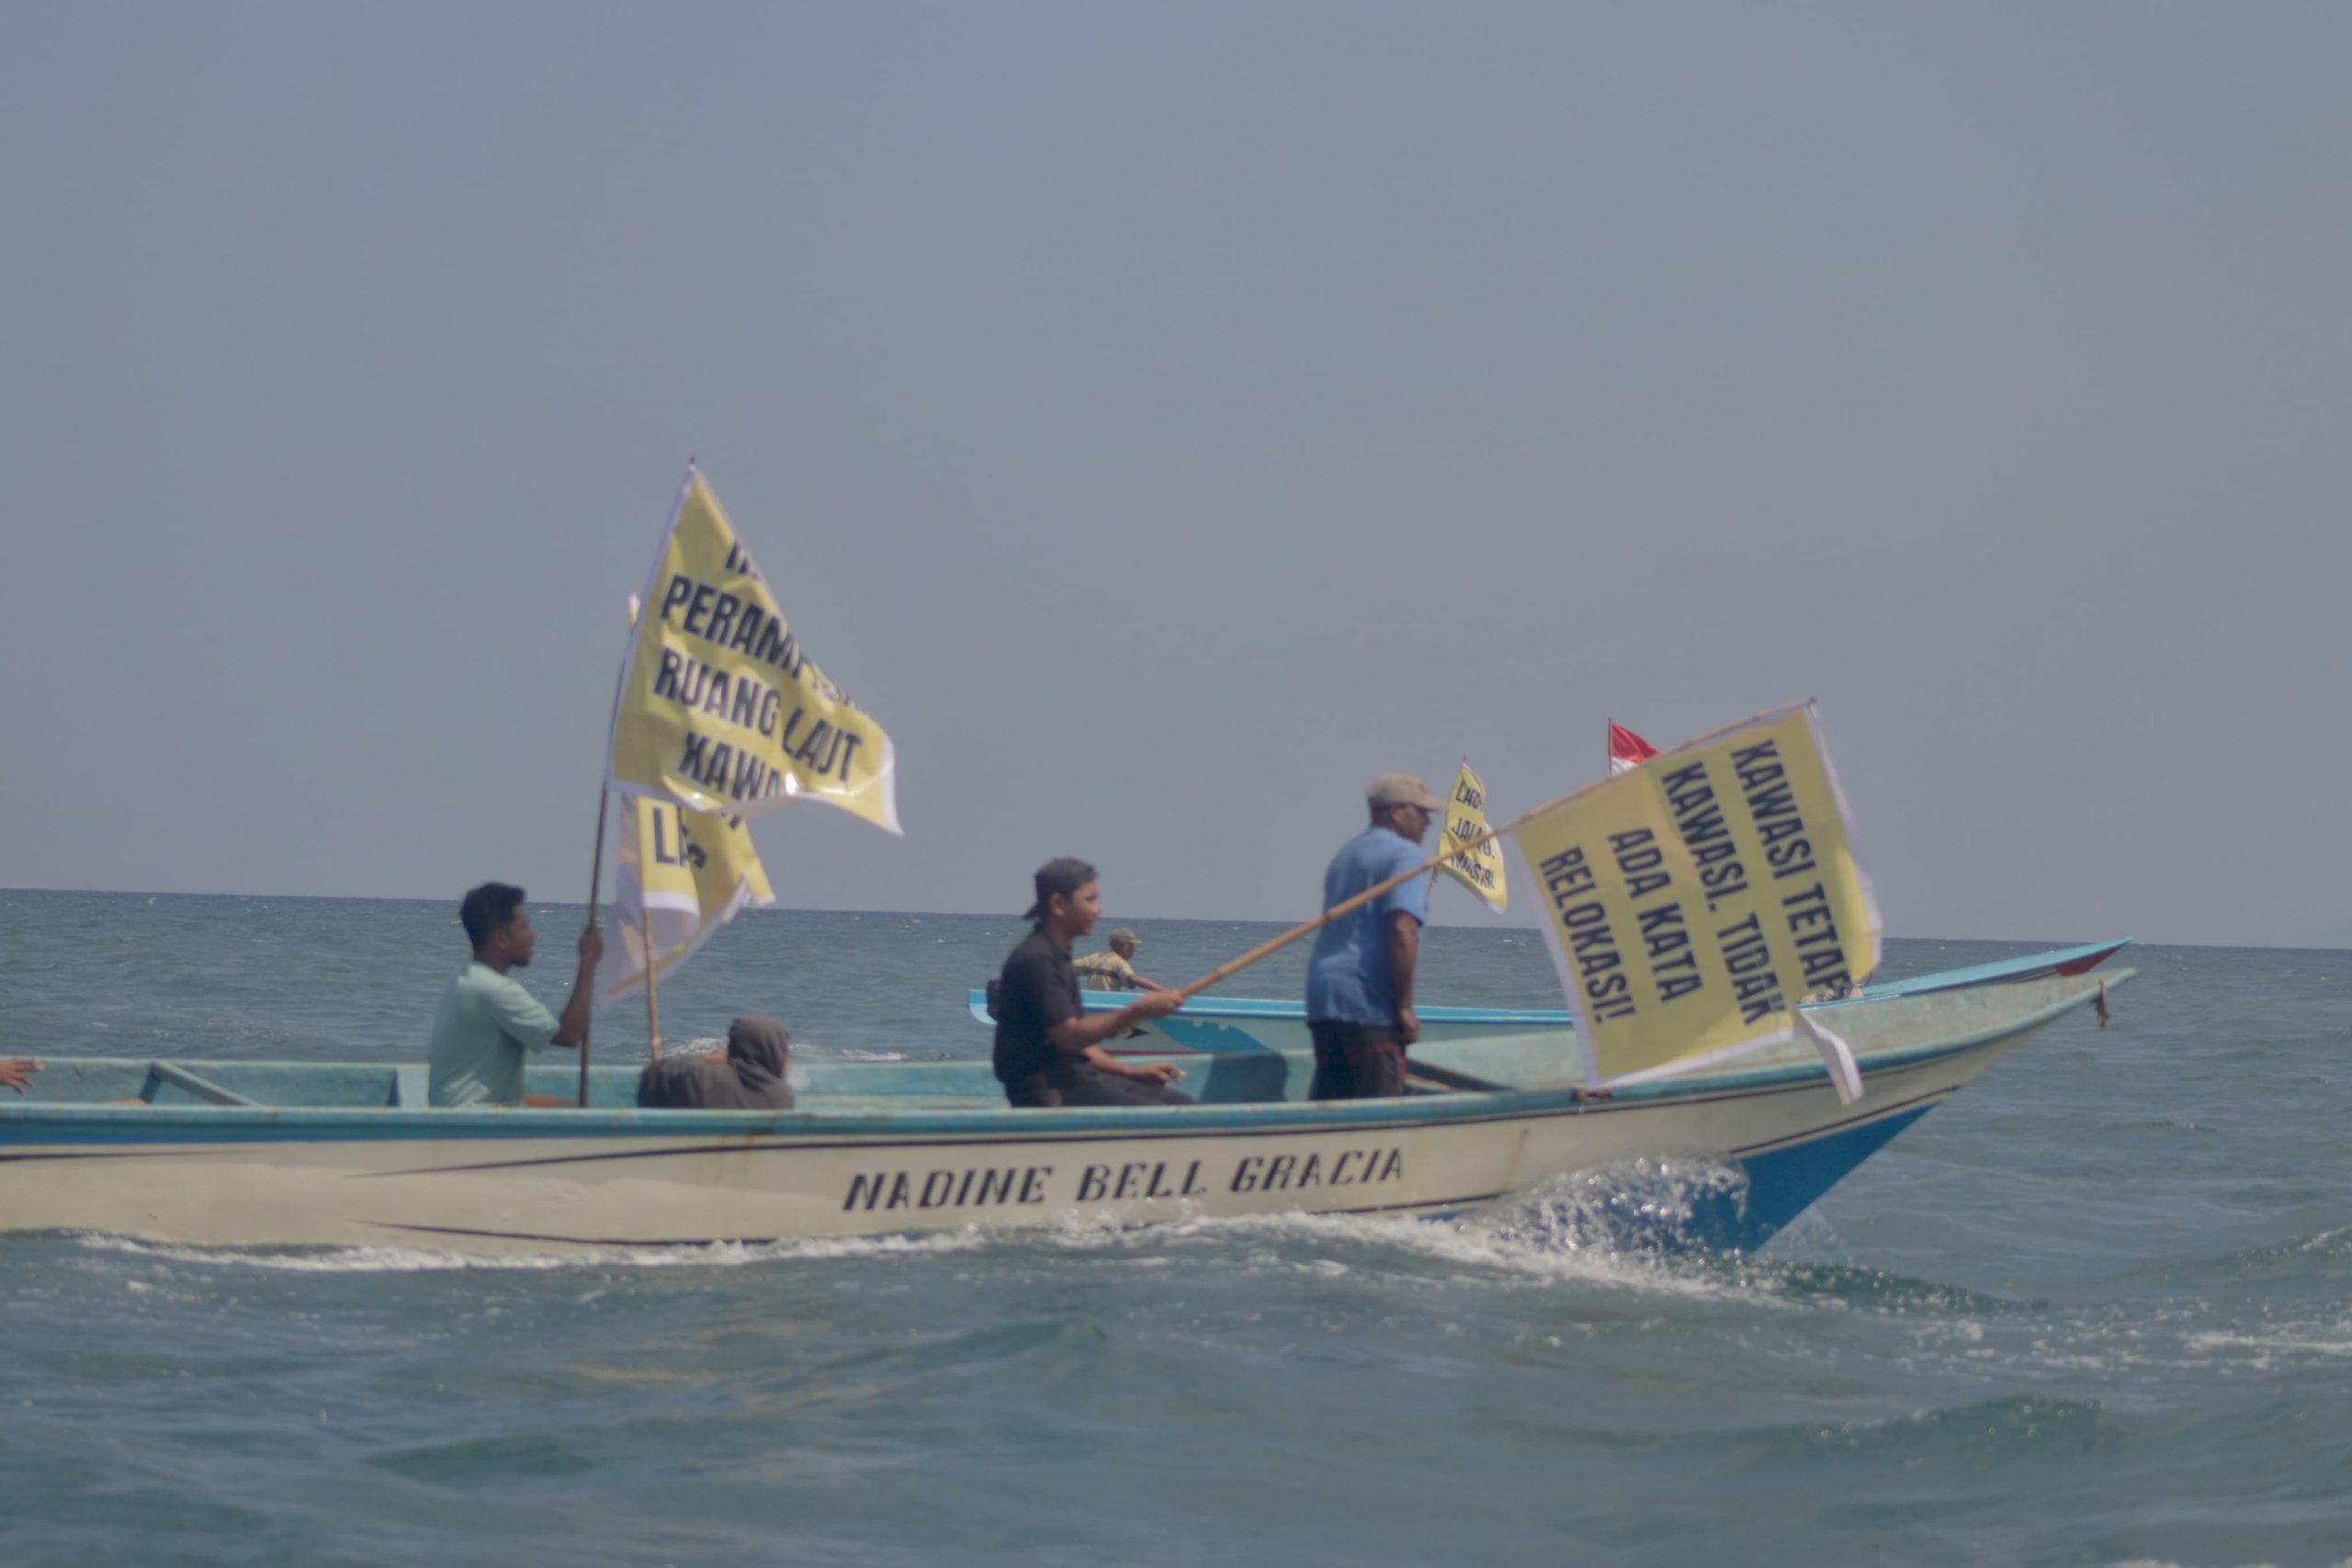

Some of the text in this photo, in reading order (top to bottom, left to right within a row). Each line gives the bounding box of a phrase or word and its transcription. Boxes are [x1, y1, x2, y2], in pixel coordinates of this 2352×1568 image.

[653, 646, 782, 739] RUANG
[1731, 739, 1816, 880] KAWASI
[1540, 846, 1635, 1023] RELOKASI!
[1607, 828, 1703, 1003] ADA KATA
[1661, 761, 1786, 1026] KAWASI. TIDAK
[842, 1147, 1402, 1211] NADINE BELL GRACIA
